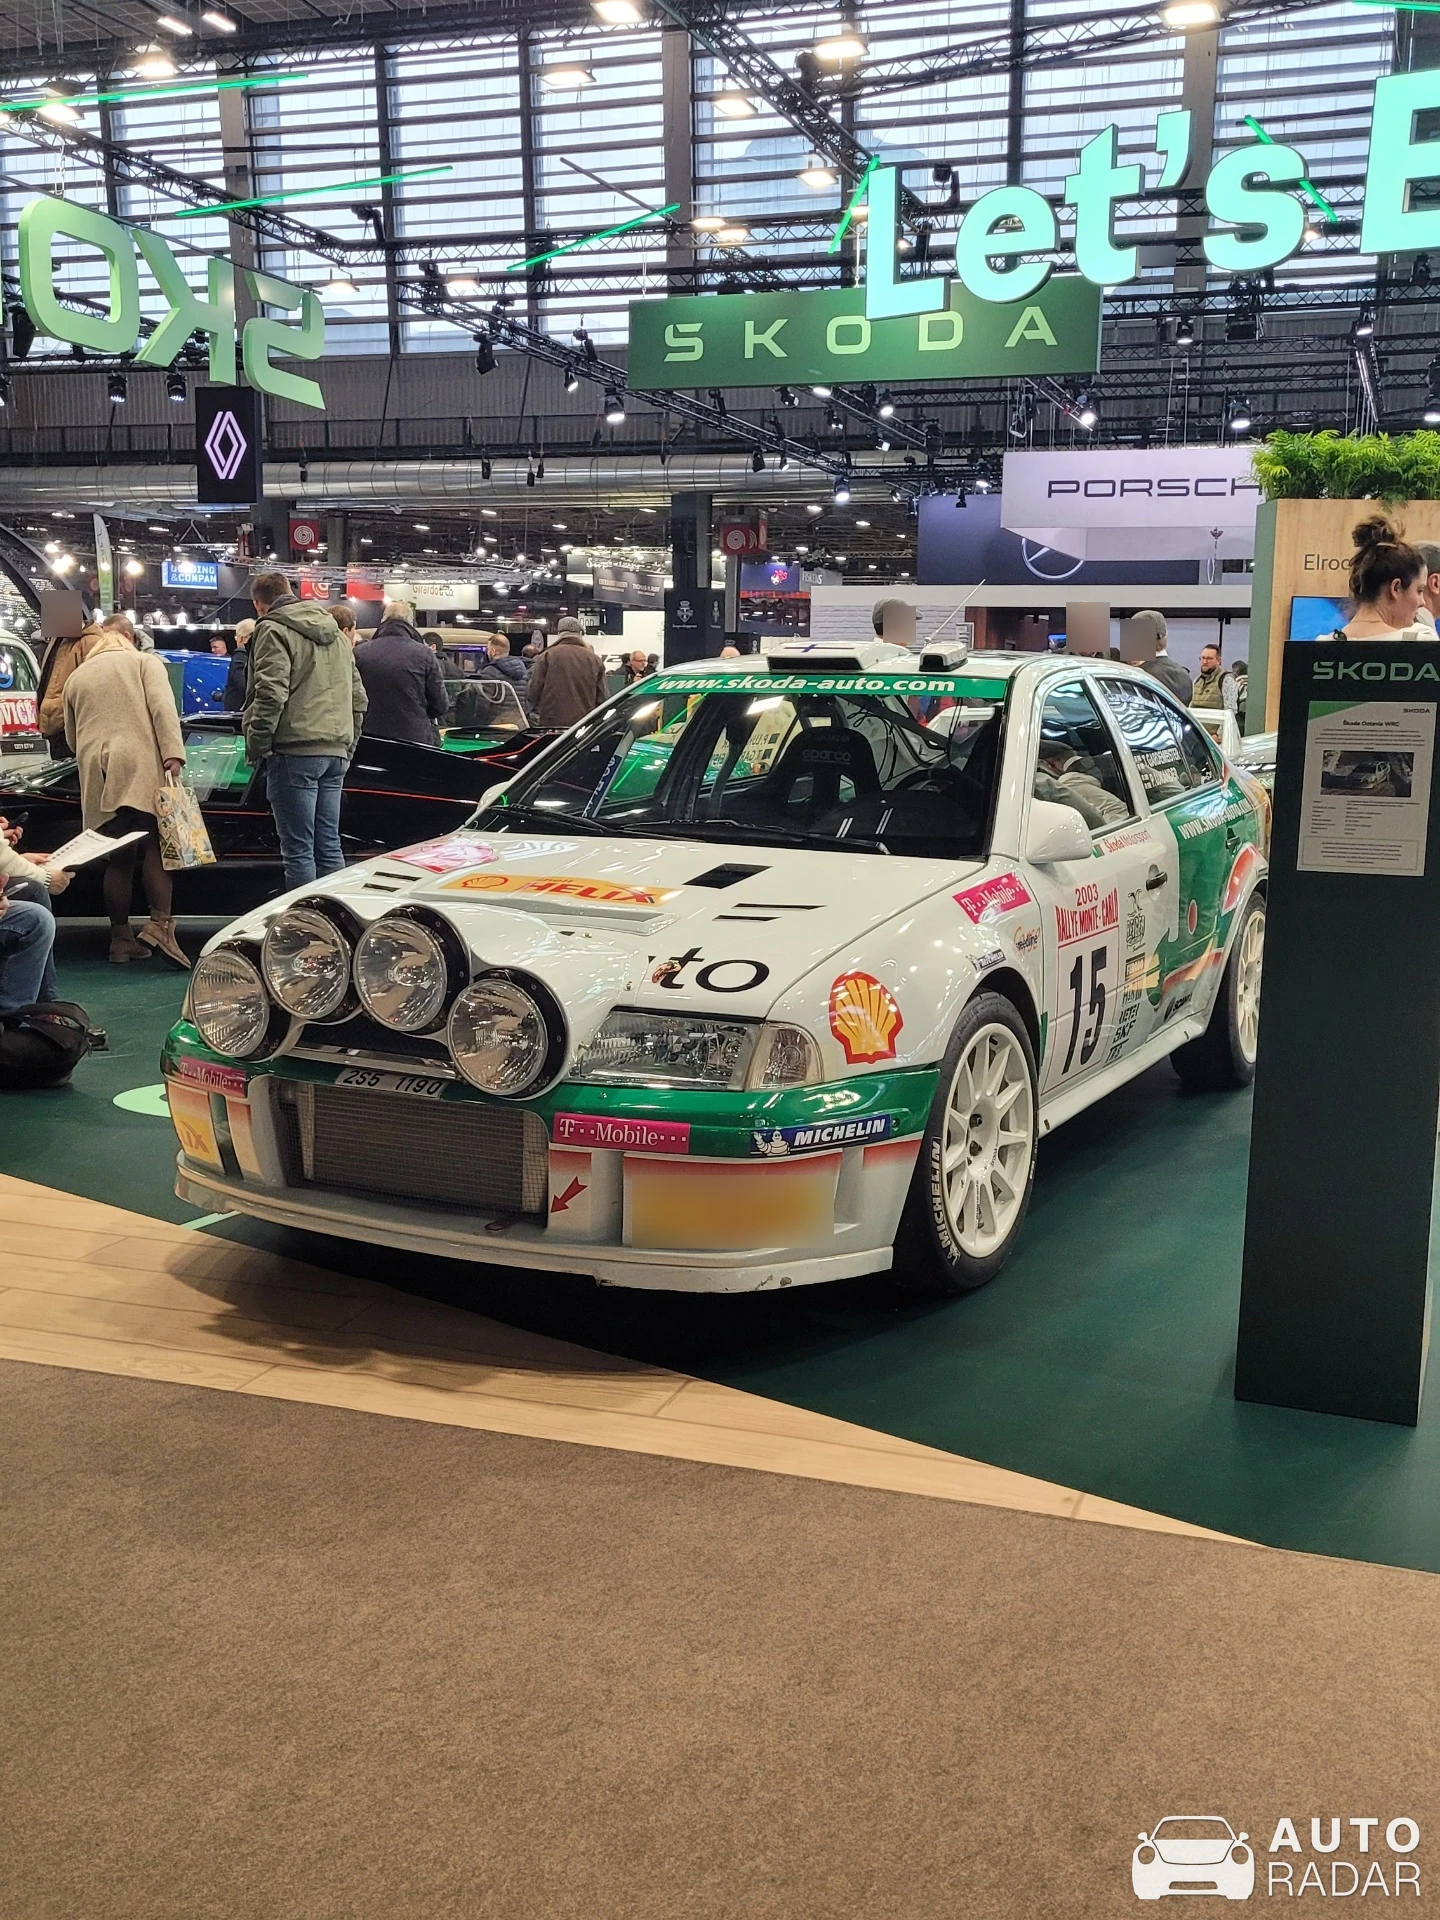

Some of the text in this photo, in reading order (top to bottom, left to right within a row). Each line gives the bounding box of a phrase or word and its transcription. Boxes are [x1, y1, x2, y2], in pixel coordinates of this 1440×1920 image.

[865, 69, 1440, 322] Let's E
[1048, 478, 1263, 498] PORSCH
[656, 675, 956, 692] www.skoda-auto.com
[526, 881, 658, 904] HELIX
[1075, 883, 1099, 907] 2003
[1055, 904, 1079, 943] RALLYE
[648, 946, 770, 994] to
[1062, 945, 1109, 1075] 15
[1112, 1019, 1136, 1044] SKF
[342, 1069, 443, 1095] 2S5 1190
[794, 1117, 886, 1147] MICHELIN
[930, 1137, 954, 1250] MICHELIN
